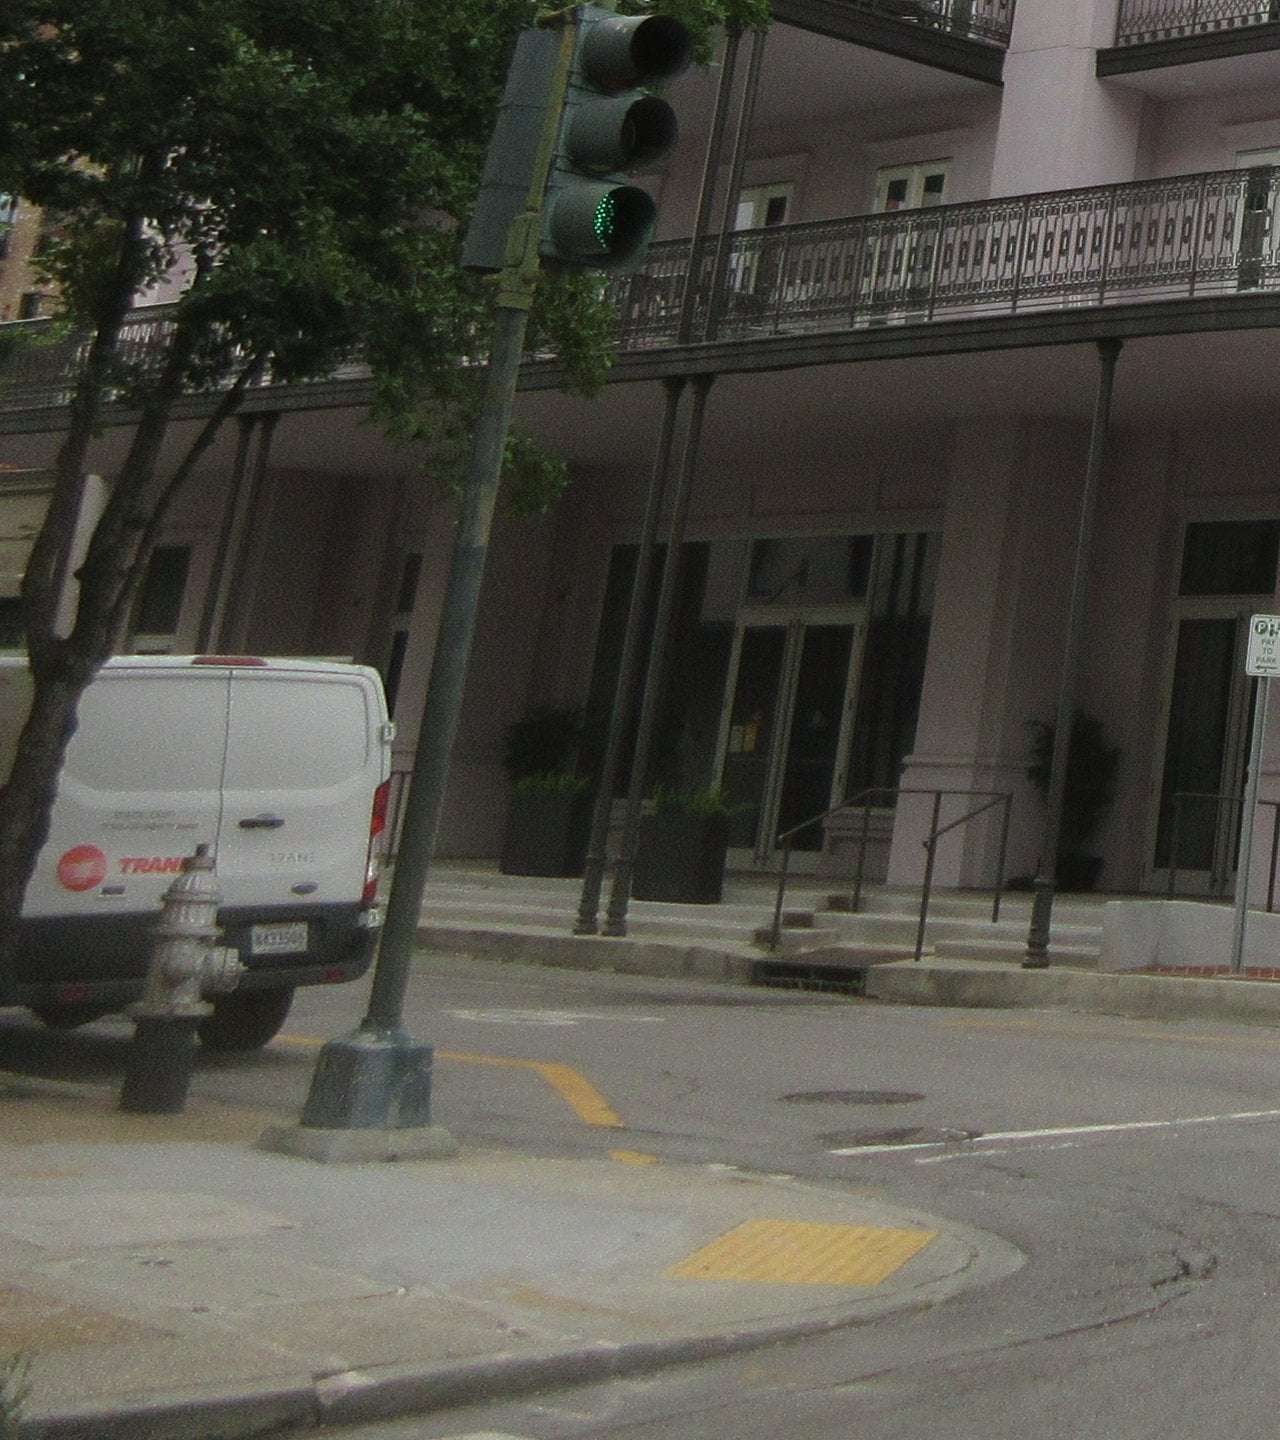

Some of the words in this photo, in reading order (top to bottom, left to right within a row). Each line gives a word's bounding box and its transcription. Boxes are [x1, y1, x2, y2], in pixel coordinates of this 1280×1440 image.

[1261, 638, 1275, 646] PAY
[1256, 656, 1277, 664] PARK
[119, 857, 184, 874] TRAN
